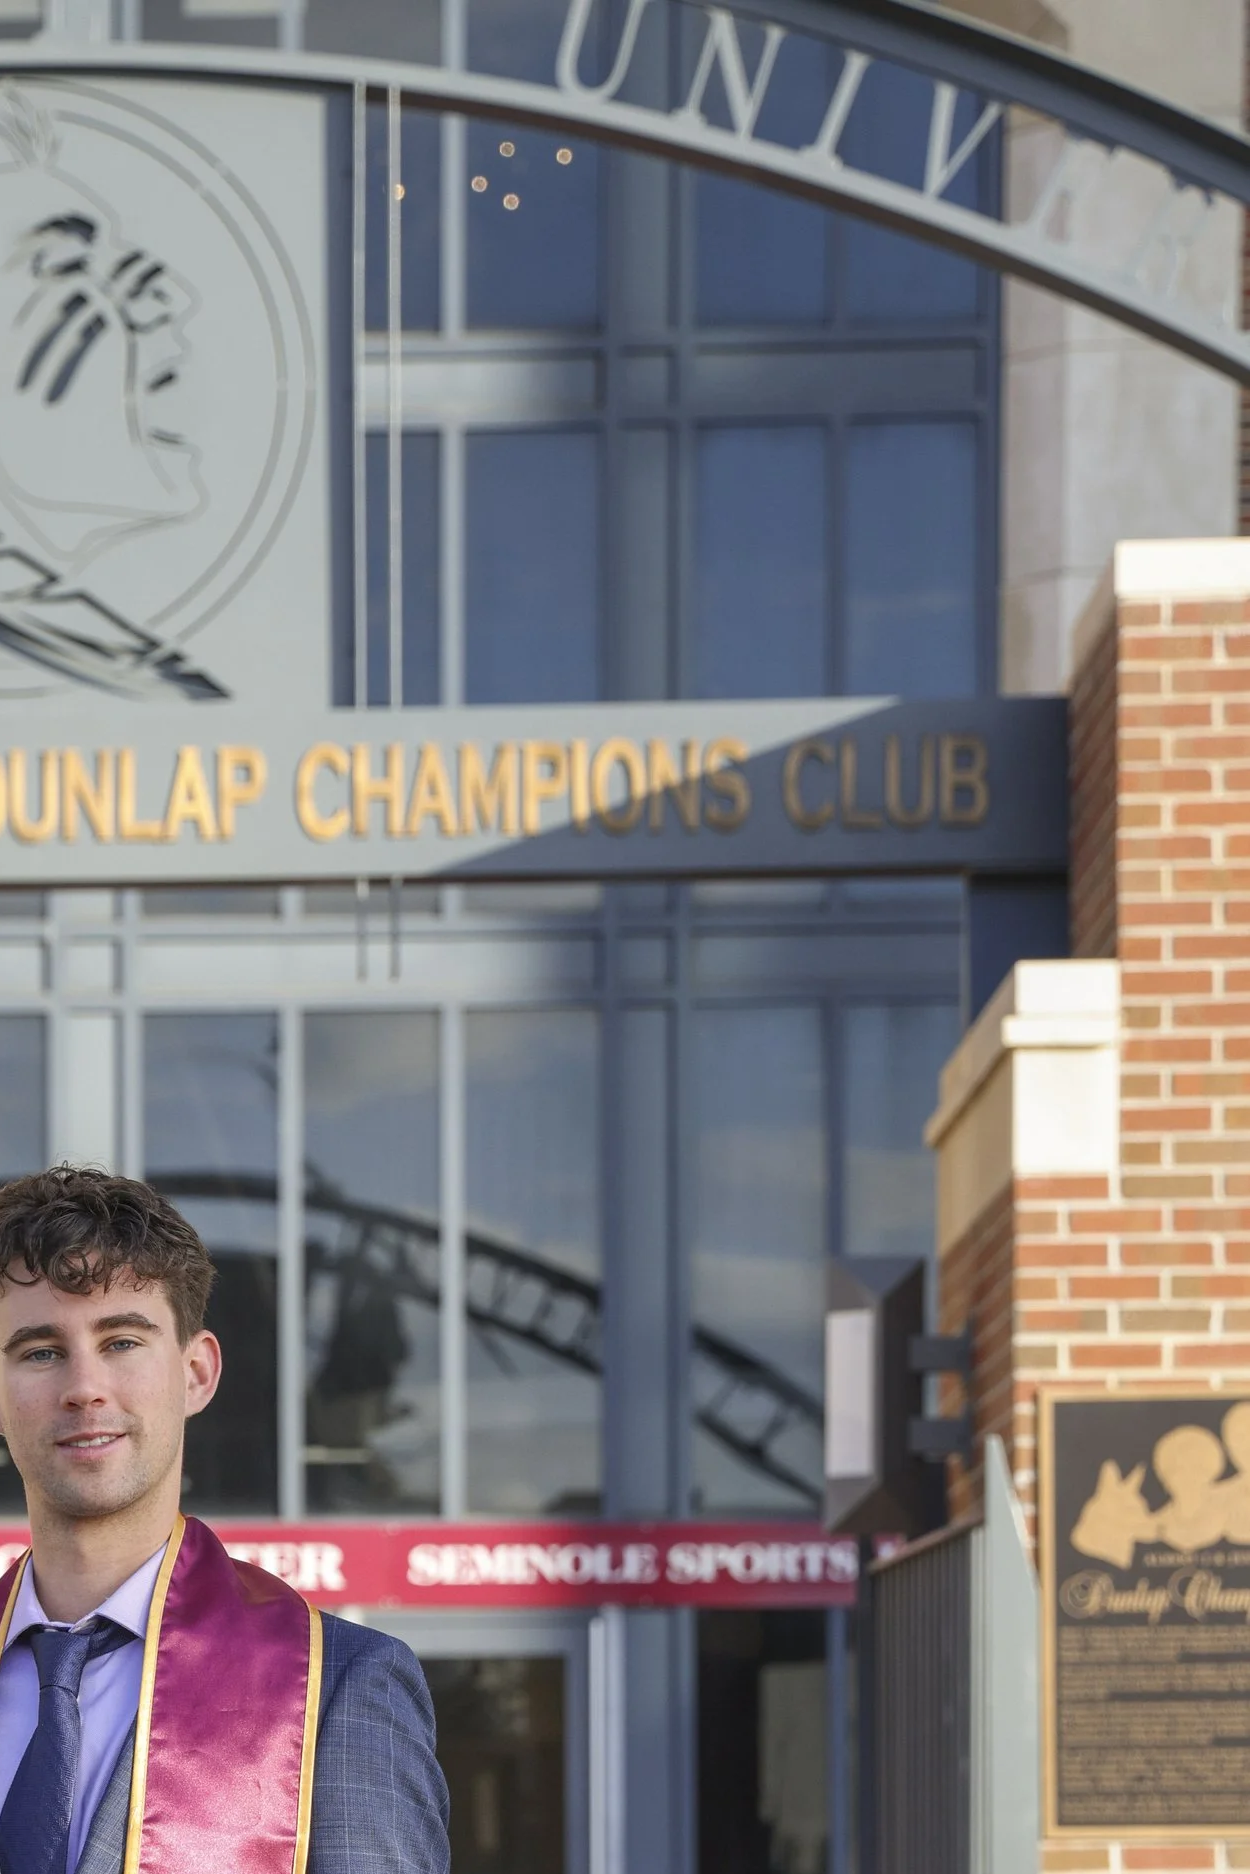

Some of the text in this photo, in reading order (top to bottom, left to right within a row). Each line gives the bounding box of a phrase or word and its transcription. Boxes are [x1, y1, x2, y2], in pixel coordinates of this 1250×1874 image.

[294, 737, 750, 842] CHAMPIONS
[782, 734, 992, 832] CLUB
[407, 1541, 658, 1587] SEMINOLE
[666, 1541, 859, 1584] SPORTS
